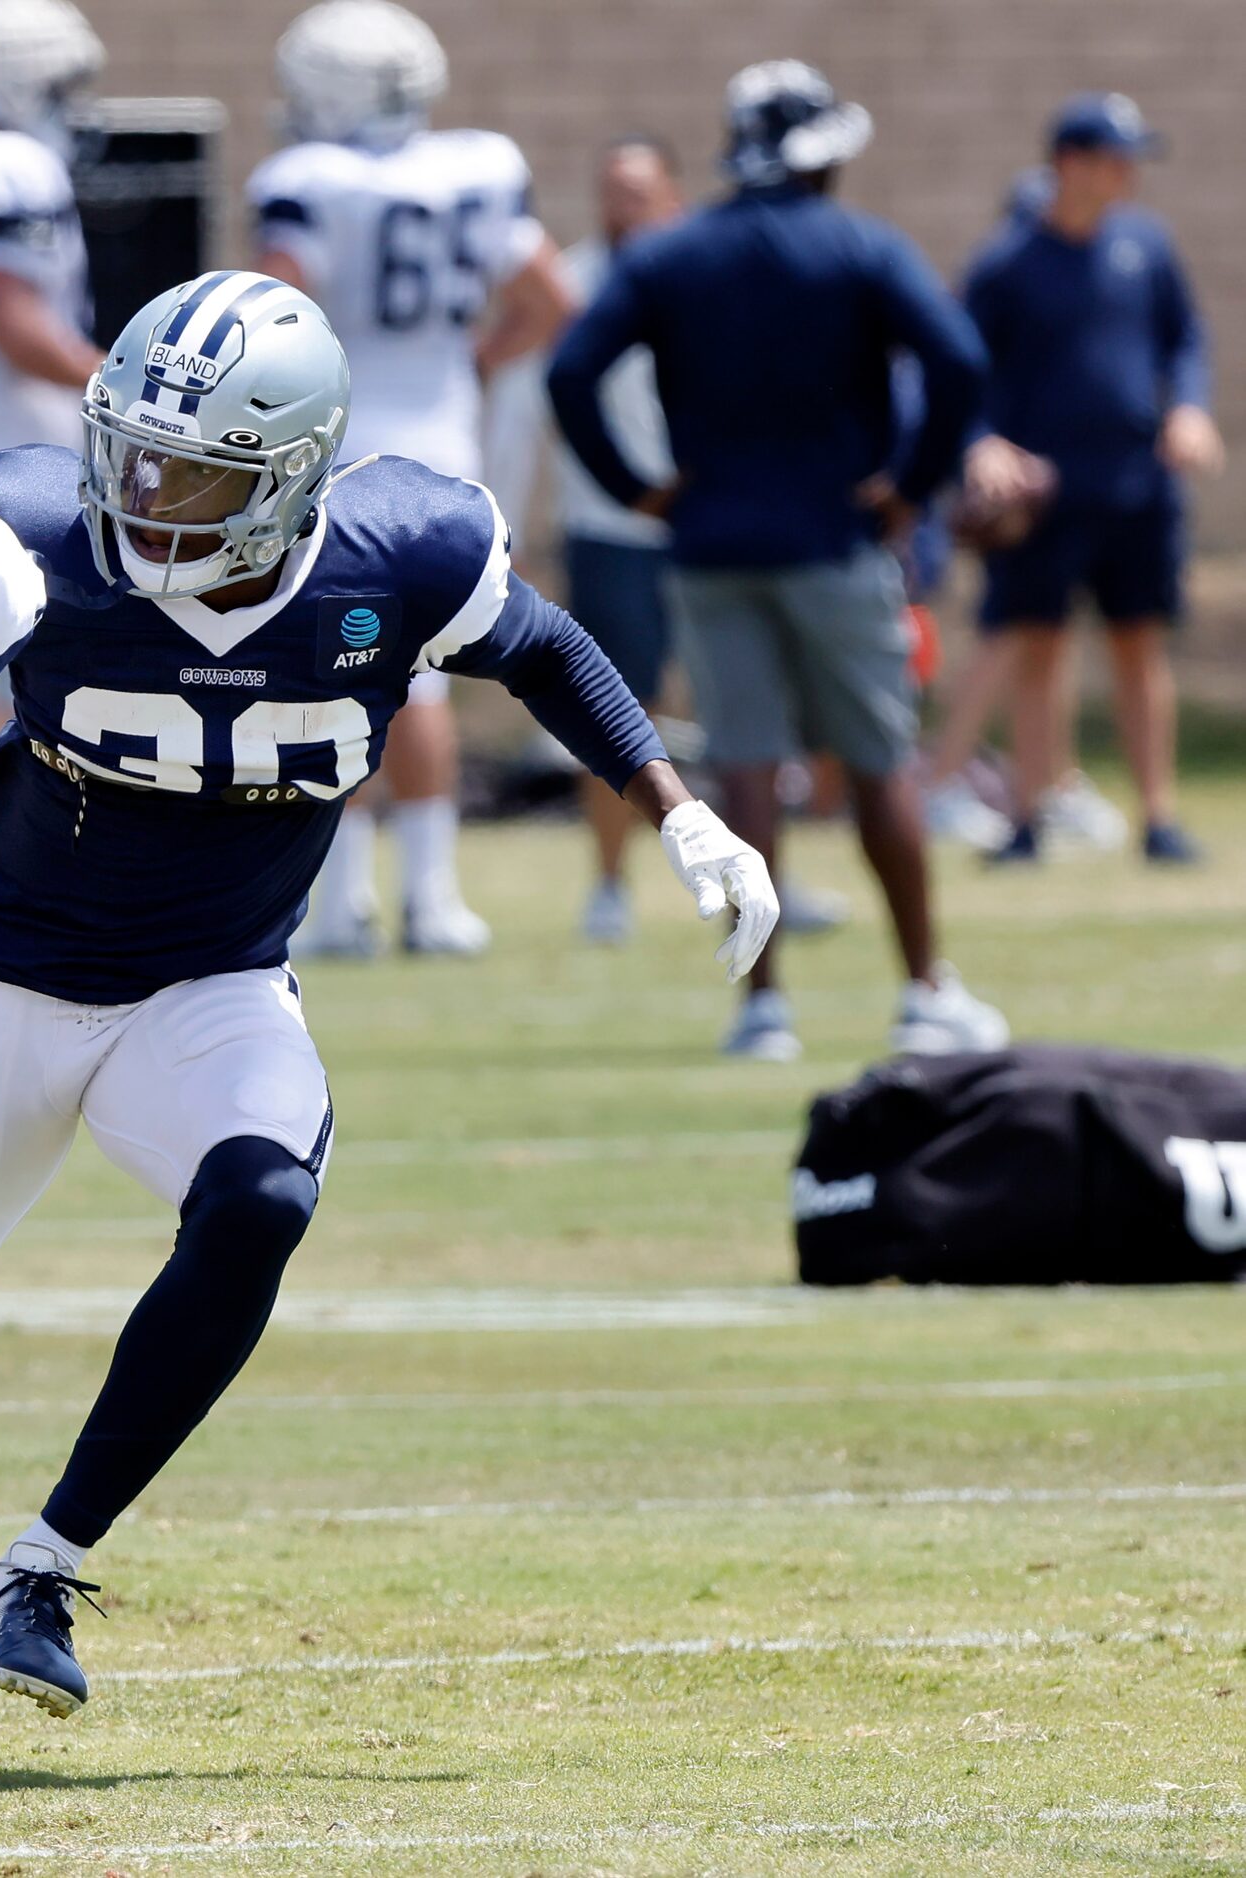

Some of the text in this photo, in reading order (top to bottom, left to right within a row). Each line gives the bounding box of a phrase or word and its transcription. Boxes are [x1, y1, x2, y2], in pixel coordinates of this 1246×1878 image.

[152, 346, 217, 380] BLAND
[139, 413, 185, 435] COWBOYS
[333, 648, 381, 670] AT&T
[180, 668, 266, 686] COWBOYS
[57, 686, 372, 800] 30
